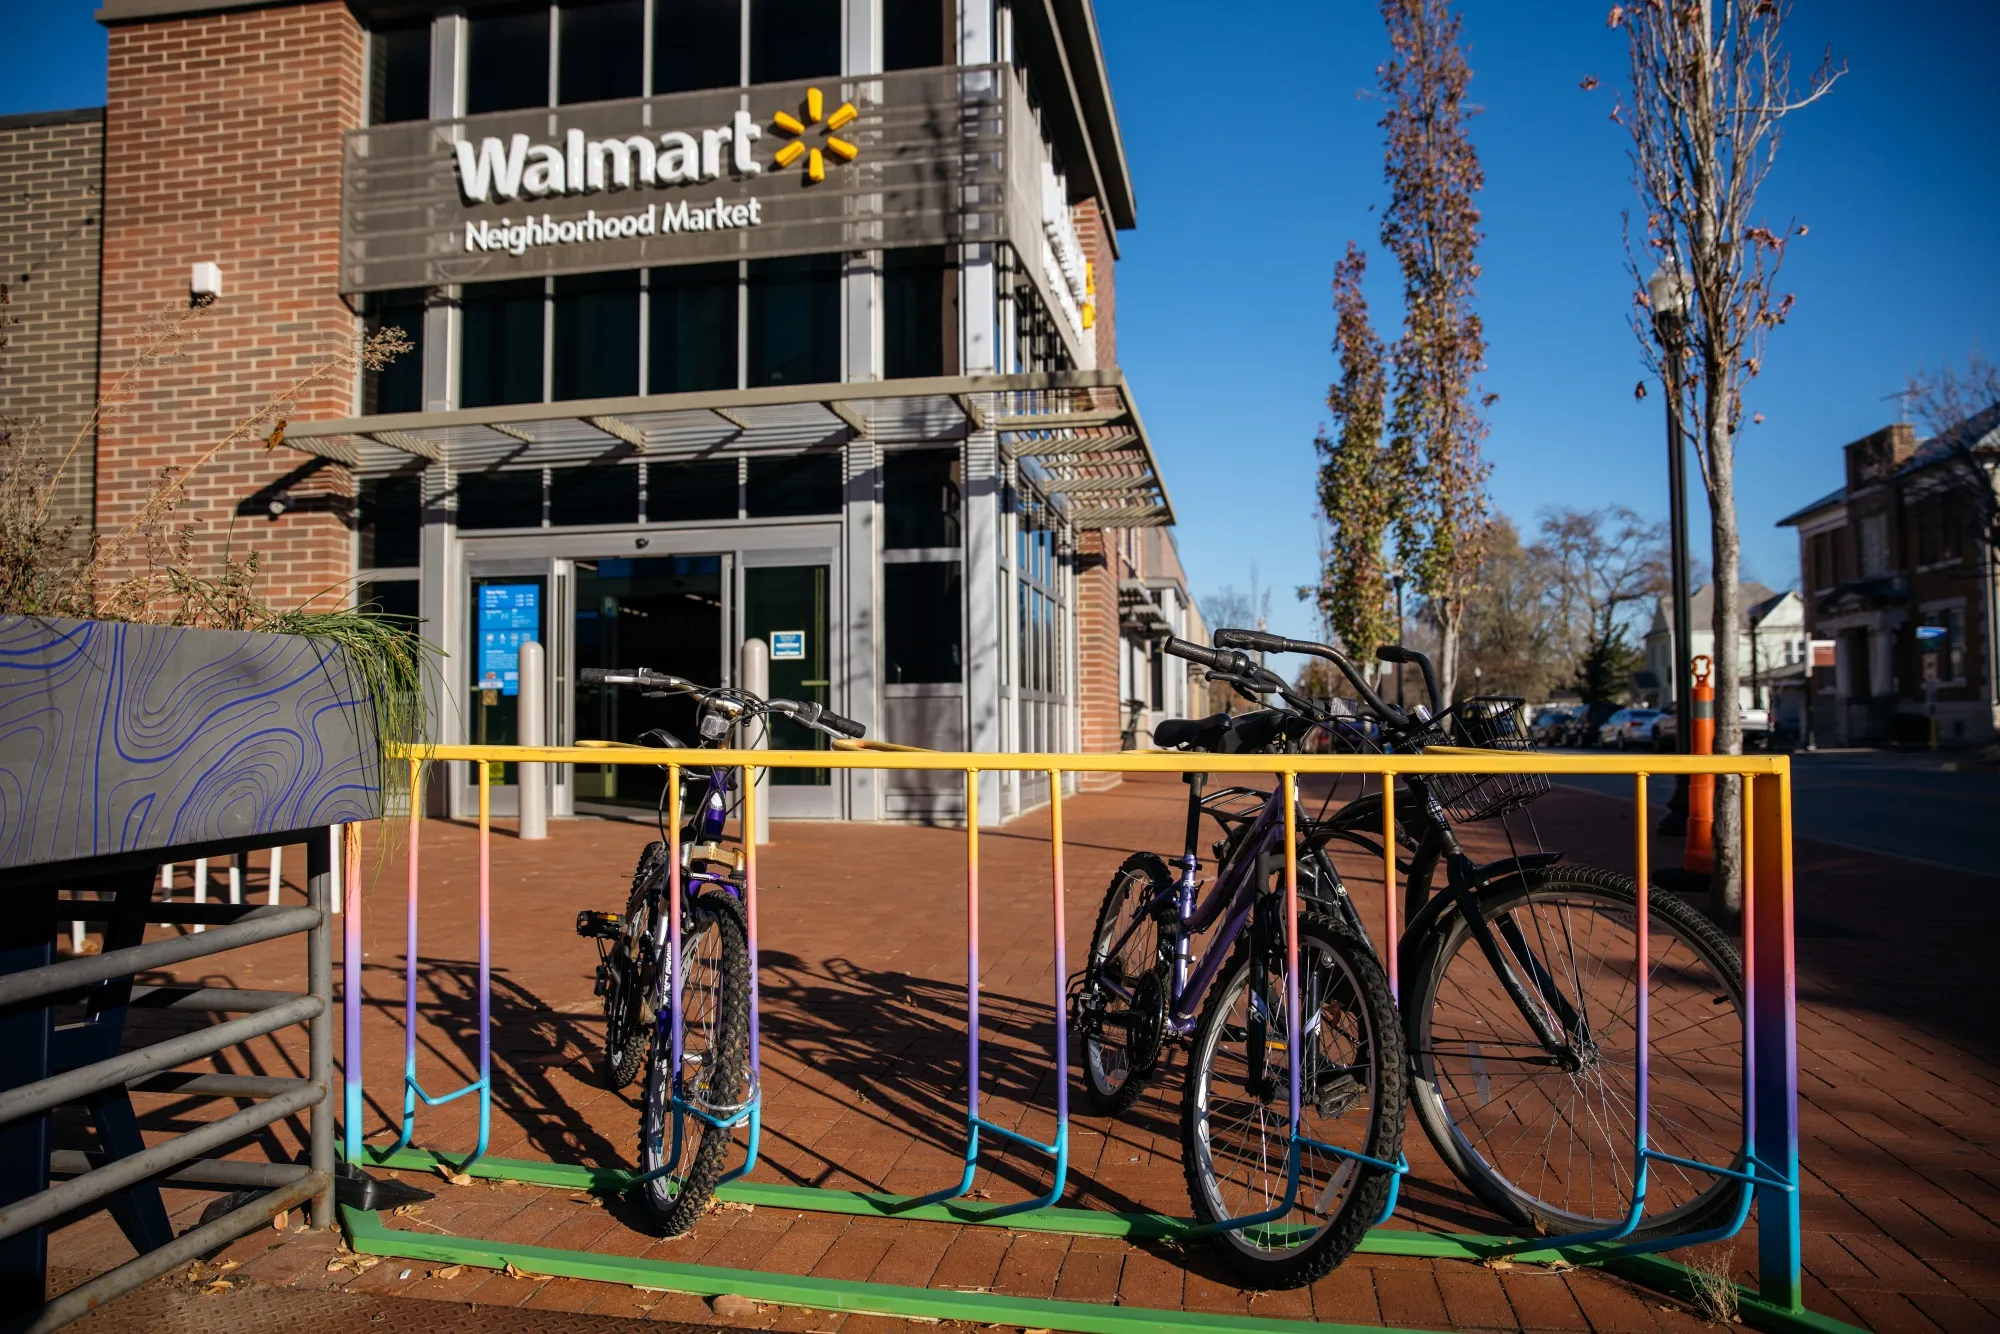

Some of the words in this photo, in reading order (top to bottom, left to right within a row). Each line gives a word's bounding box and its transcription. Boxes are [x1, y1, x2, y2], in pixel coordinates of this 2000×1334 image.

[455, 110, 761, 201] Walmart
[465, 203, 656, 256] Neighborhood
[662, 197, 761, 233] Market
